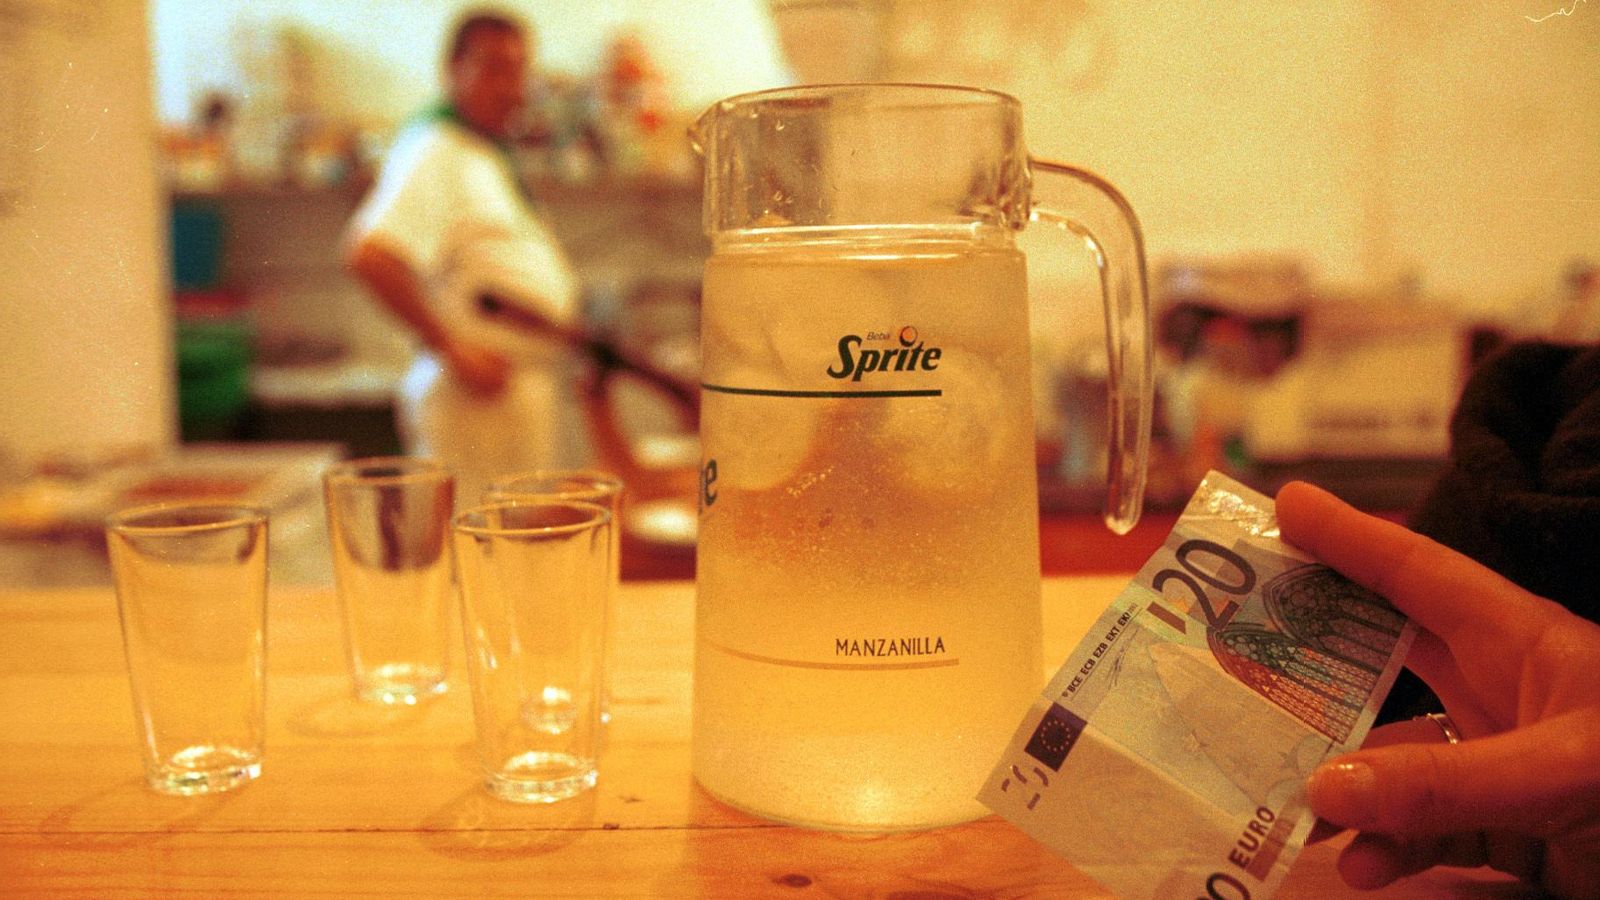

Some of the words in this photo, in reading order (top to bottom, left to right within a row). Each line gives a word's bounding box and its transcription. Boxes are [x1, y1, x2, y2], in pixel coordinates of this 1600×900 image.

[826, 326, 943, 382] Sprite
[1151, 538, 1257, 632] 20
[835, 636, 945, 657] MANZANILLA
[1067, 675, 1082, 693] BCE
[1080, 658, 1096, 675] ECB
[1093, 642, 1108, 658] EZB
[1105, 626, 1120, 642] EKT
[1228, 805, 1276, 870] EURO
